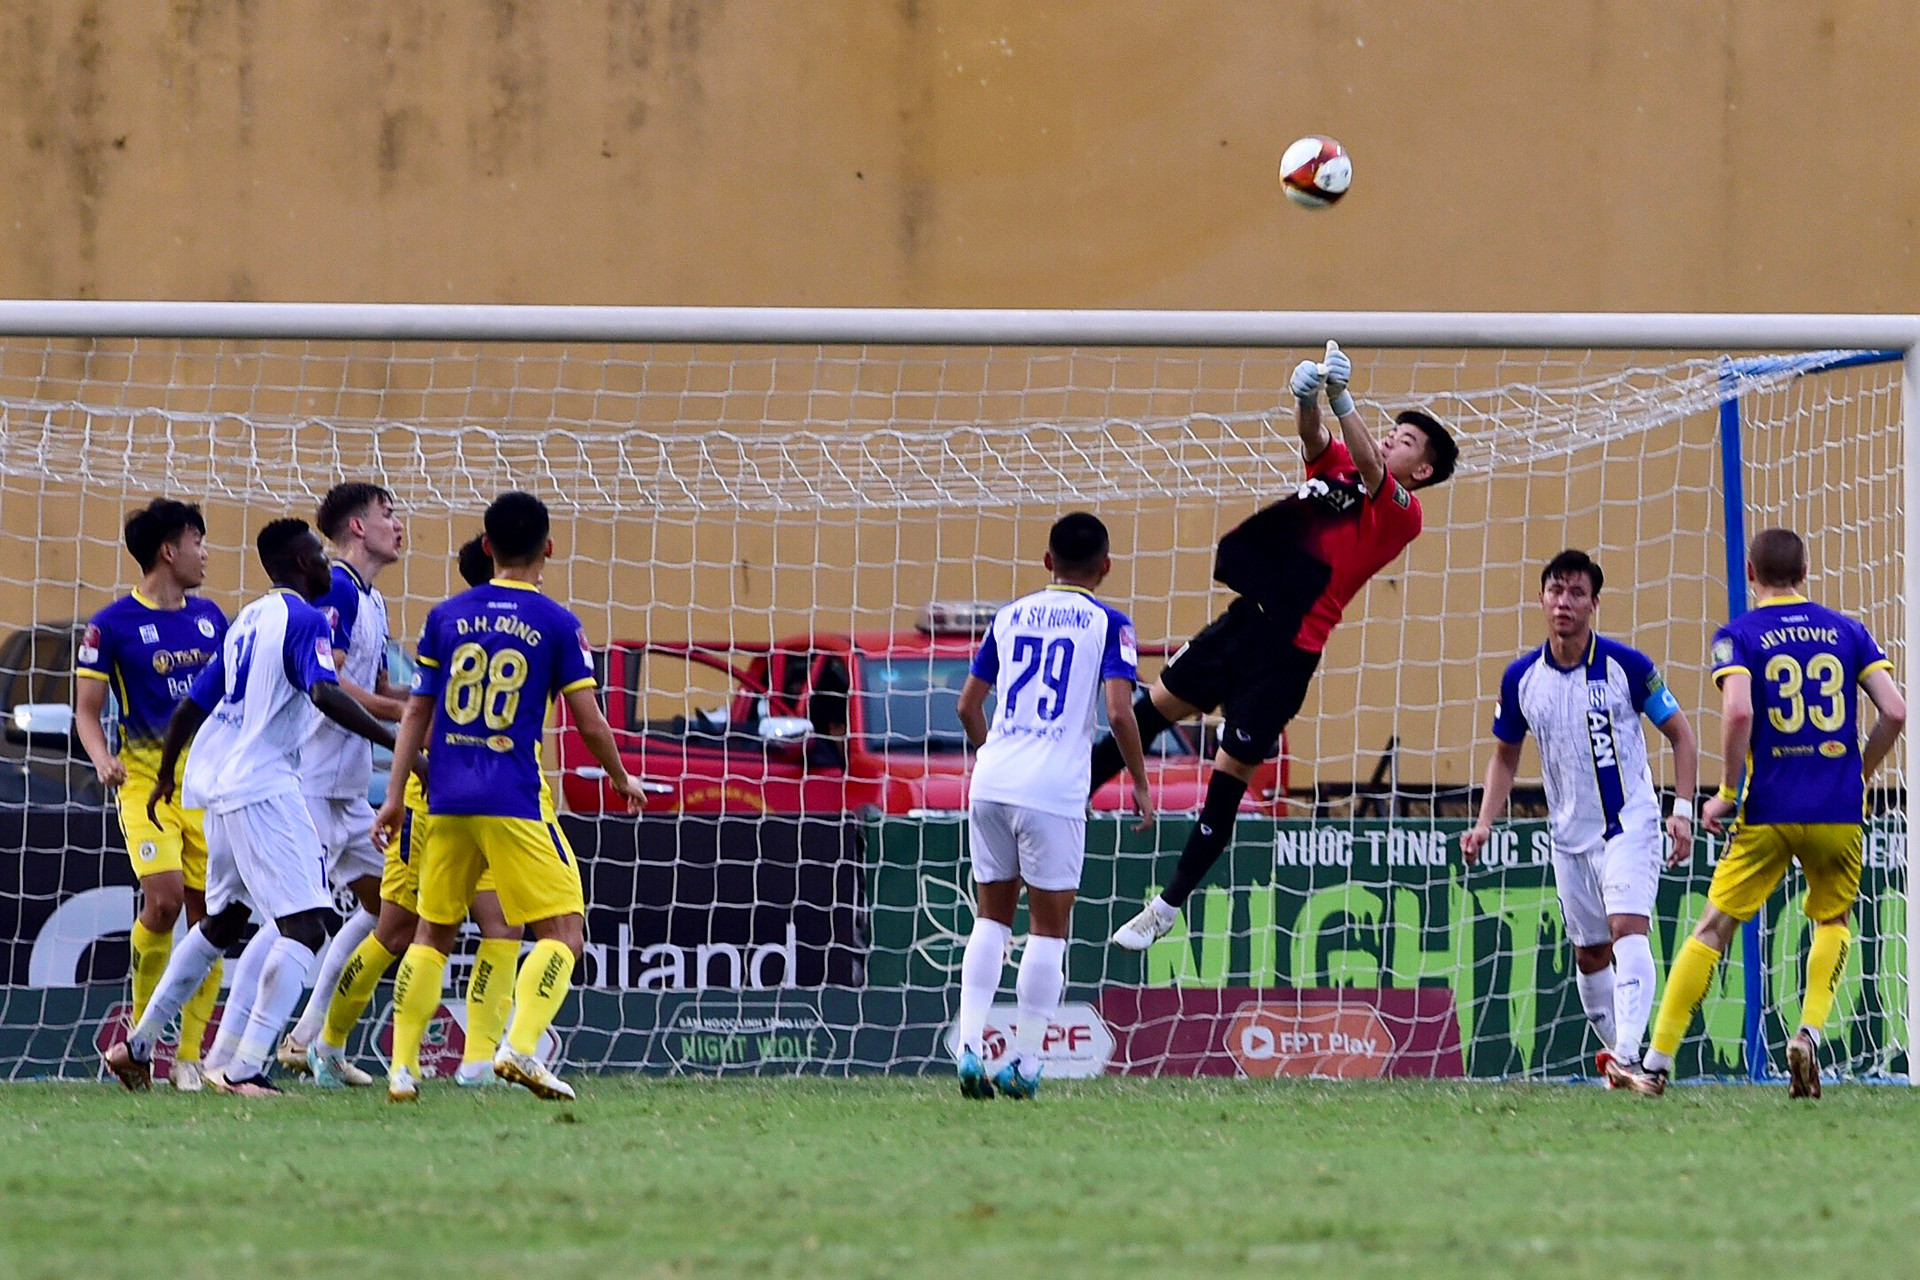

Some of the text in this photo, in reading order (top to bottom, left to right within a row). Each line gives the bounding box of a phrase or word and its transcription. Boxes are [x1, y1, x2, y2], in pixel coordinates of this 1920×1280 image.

[445, 642, 528, 730] 88
[1005, 636, 1075, 721] 79
[1765, 652, 1846, 734] 33
[1146, 863, 1563, 1082] NIGHT
[681, 1035, 747, 1062] NIGHT
[1280, 1032, 1378, 1059] FPT Play
